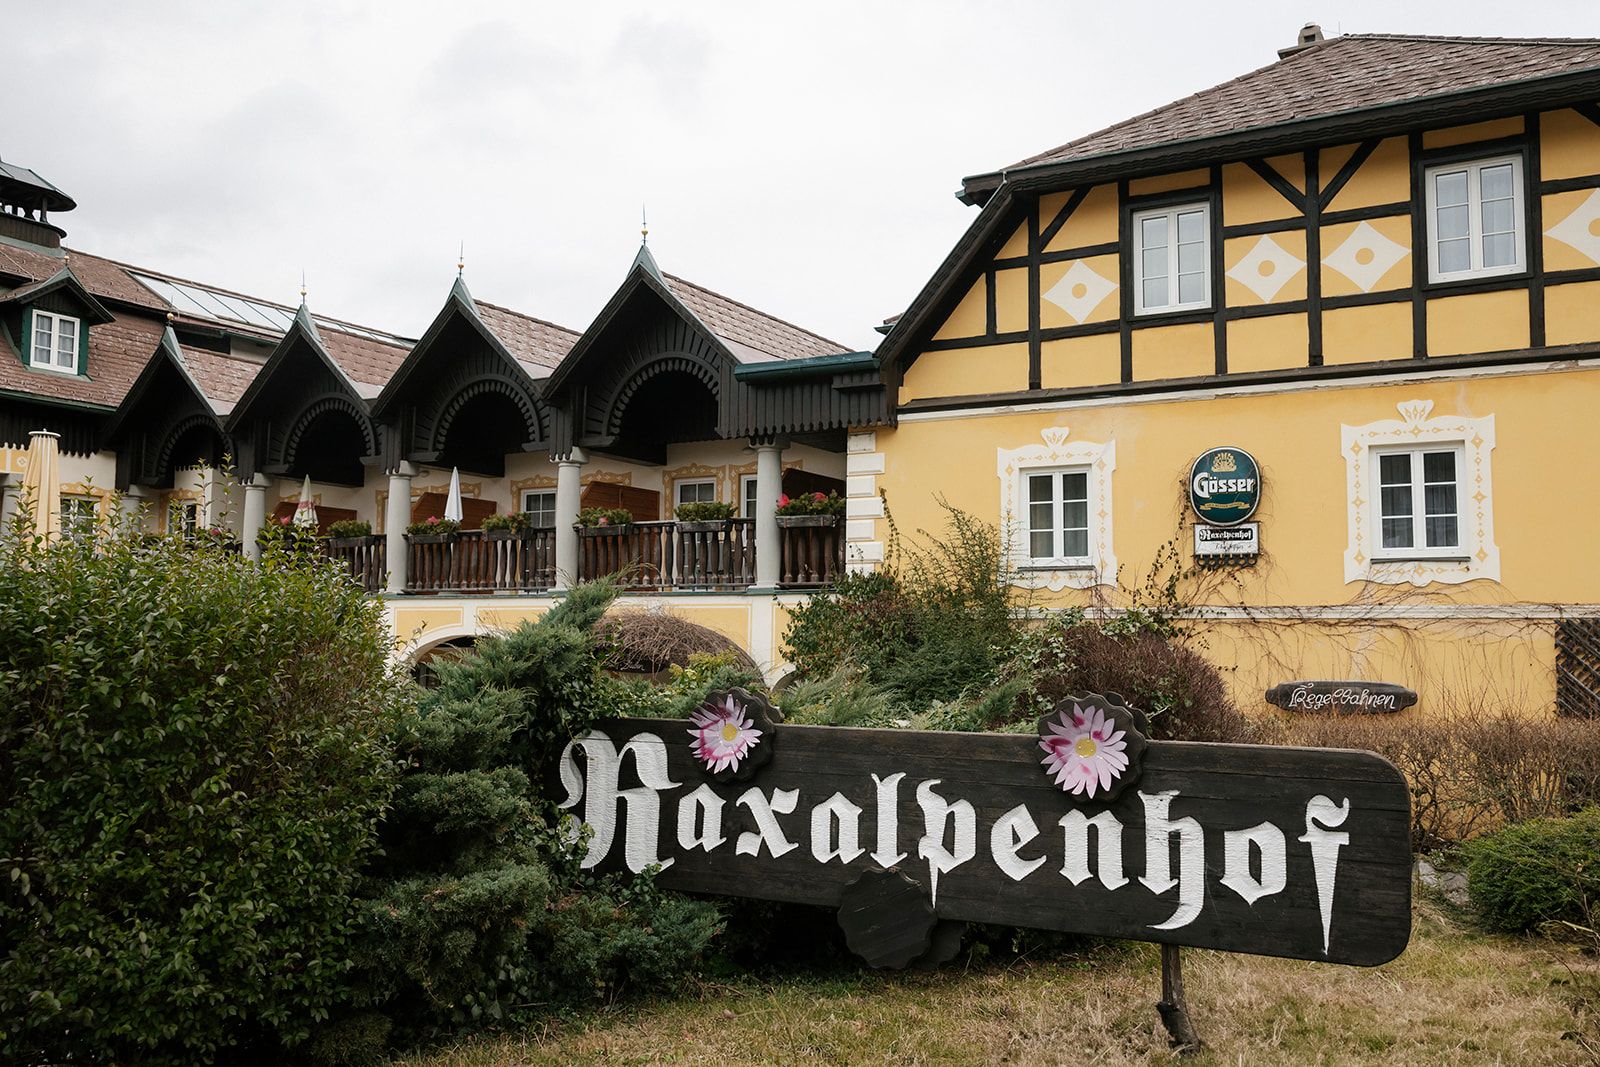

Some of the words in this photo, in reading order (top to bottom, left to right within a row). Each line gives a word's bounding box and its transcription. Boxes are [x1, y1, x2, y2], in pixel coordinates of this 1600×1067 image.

[1193, 472, 1255, 499] Gösser
[1288, 682, 1396, 711] Kegelbahnen
[556, 729, 1351, 956] Raxalpenhof
